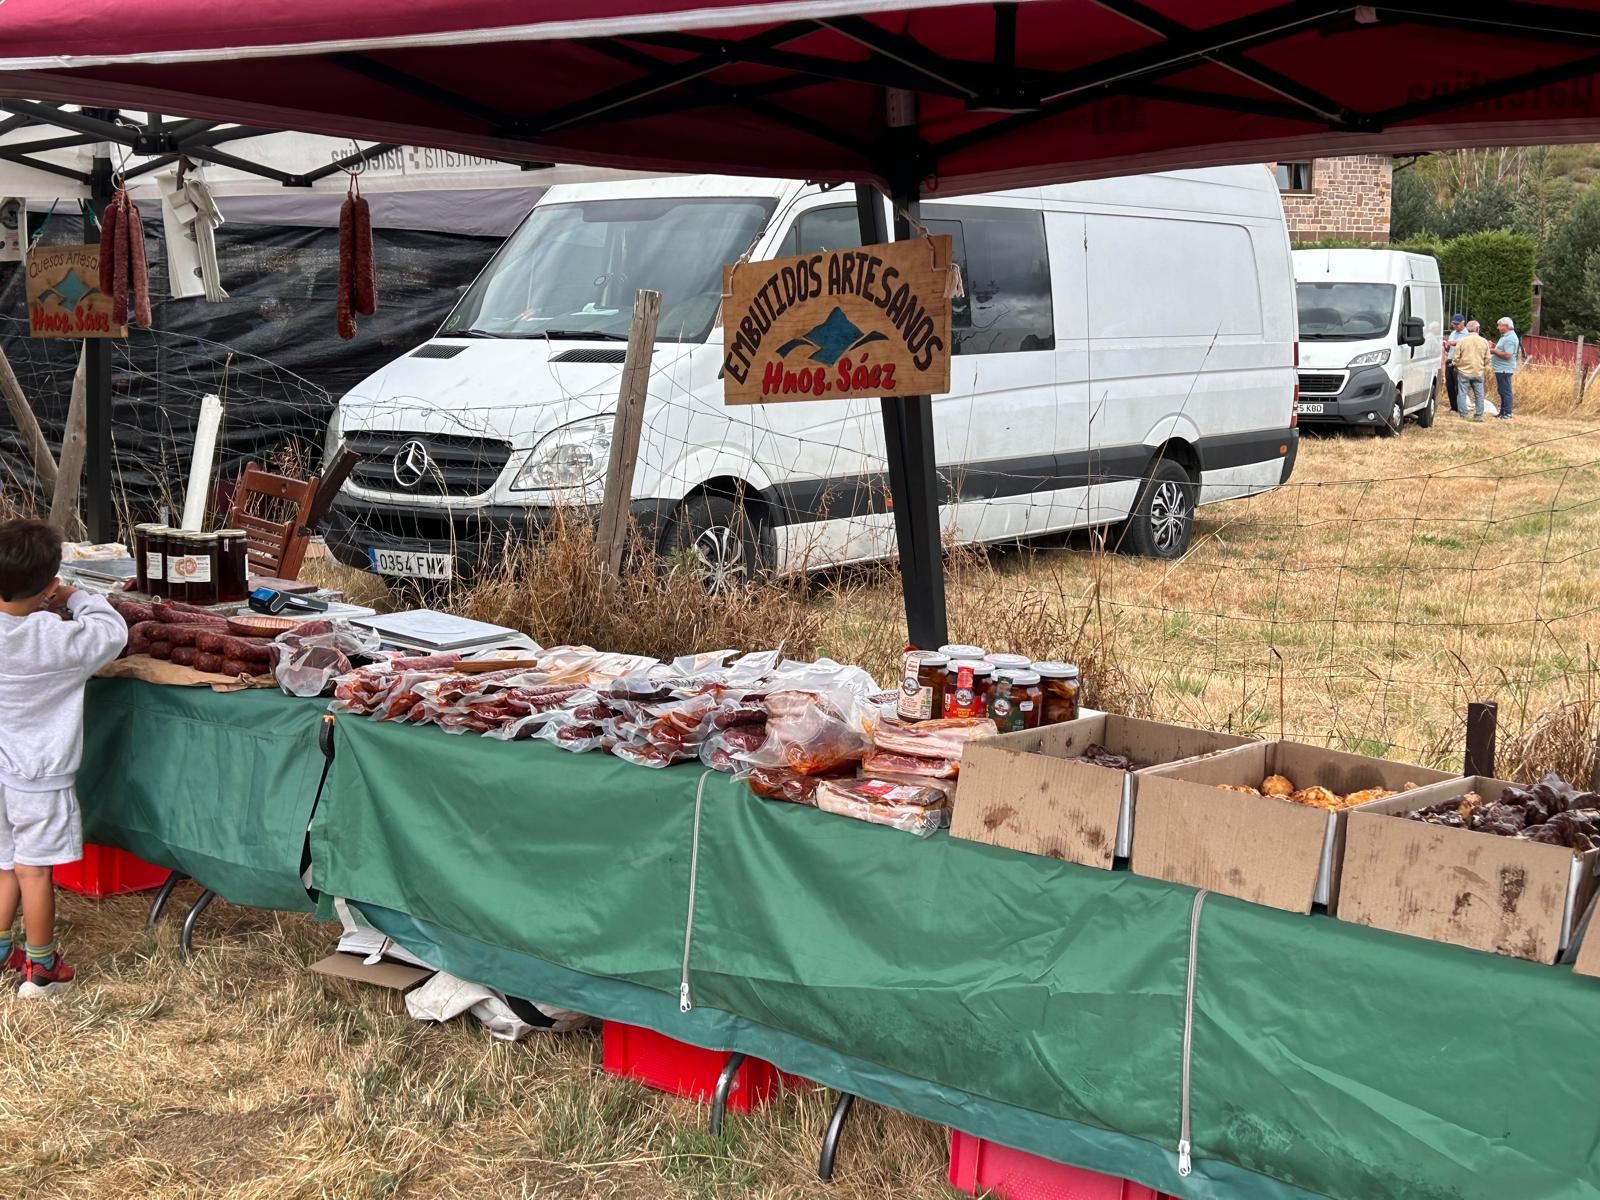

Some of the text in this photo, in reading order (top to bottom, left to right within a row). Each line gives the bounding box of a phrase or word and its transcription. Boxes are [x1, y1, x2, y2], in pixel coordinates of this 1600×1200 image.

[29, 251, 100, 278] Quesos Artesa
[75, 303, 110, 333] Sáez
[724, 252, 944, 385] EMBUTIDOS ARTESANOS
[762, 353, 897, 396] Hnos. Sáez
[1306, 404, 1322, 413] KBD
[379, 553, 413, 574] 0354
